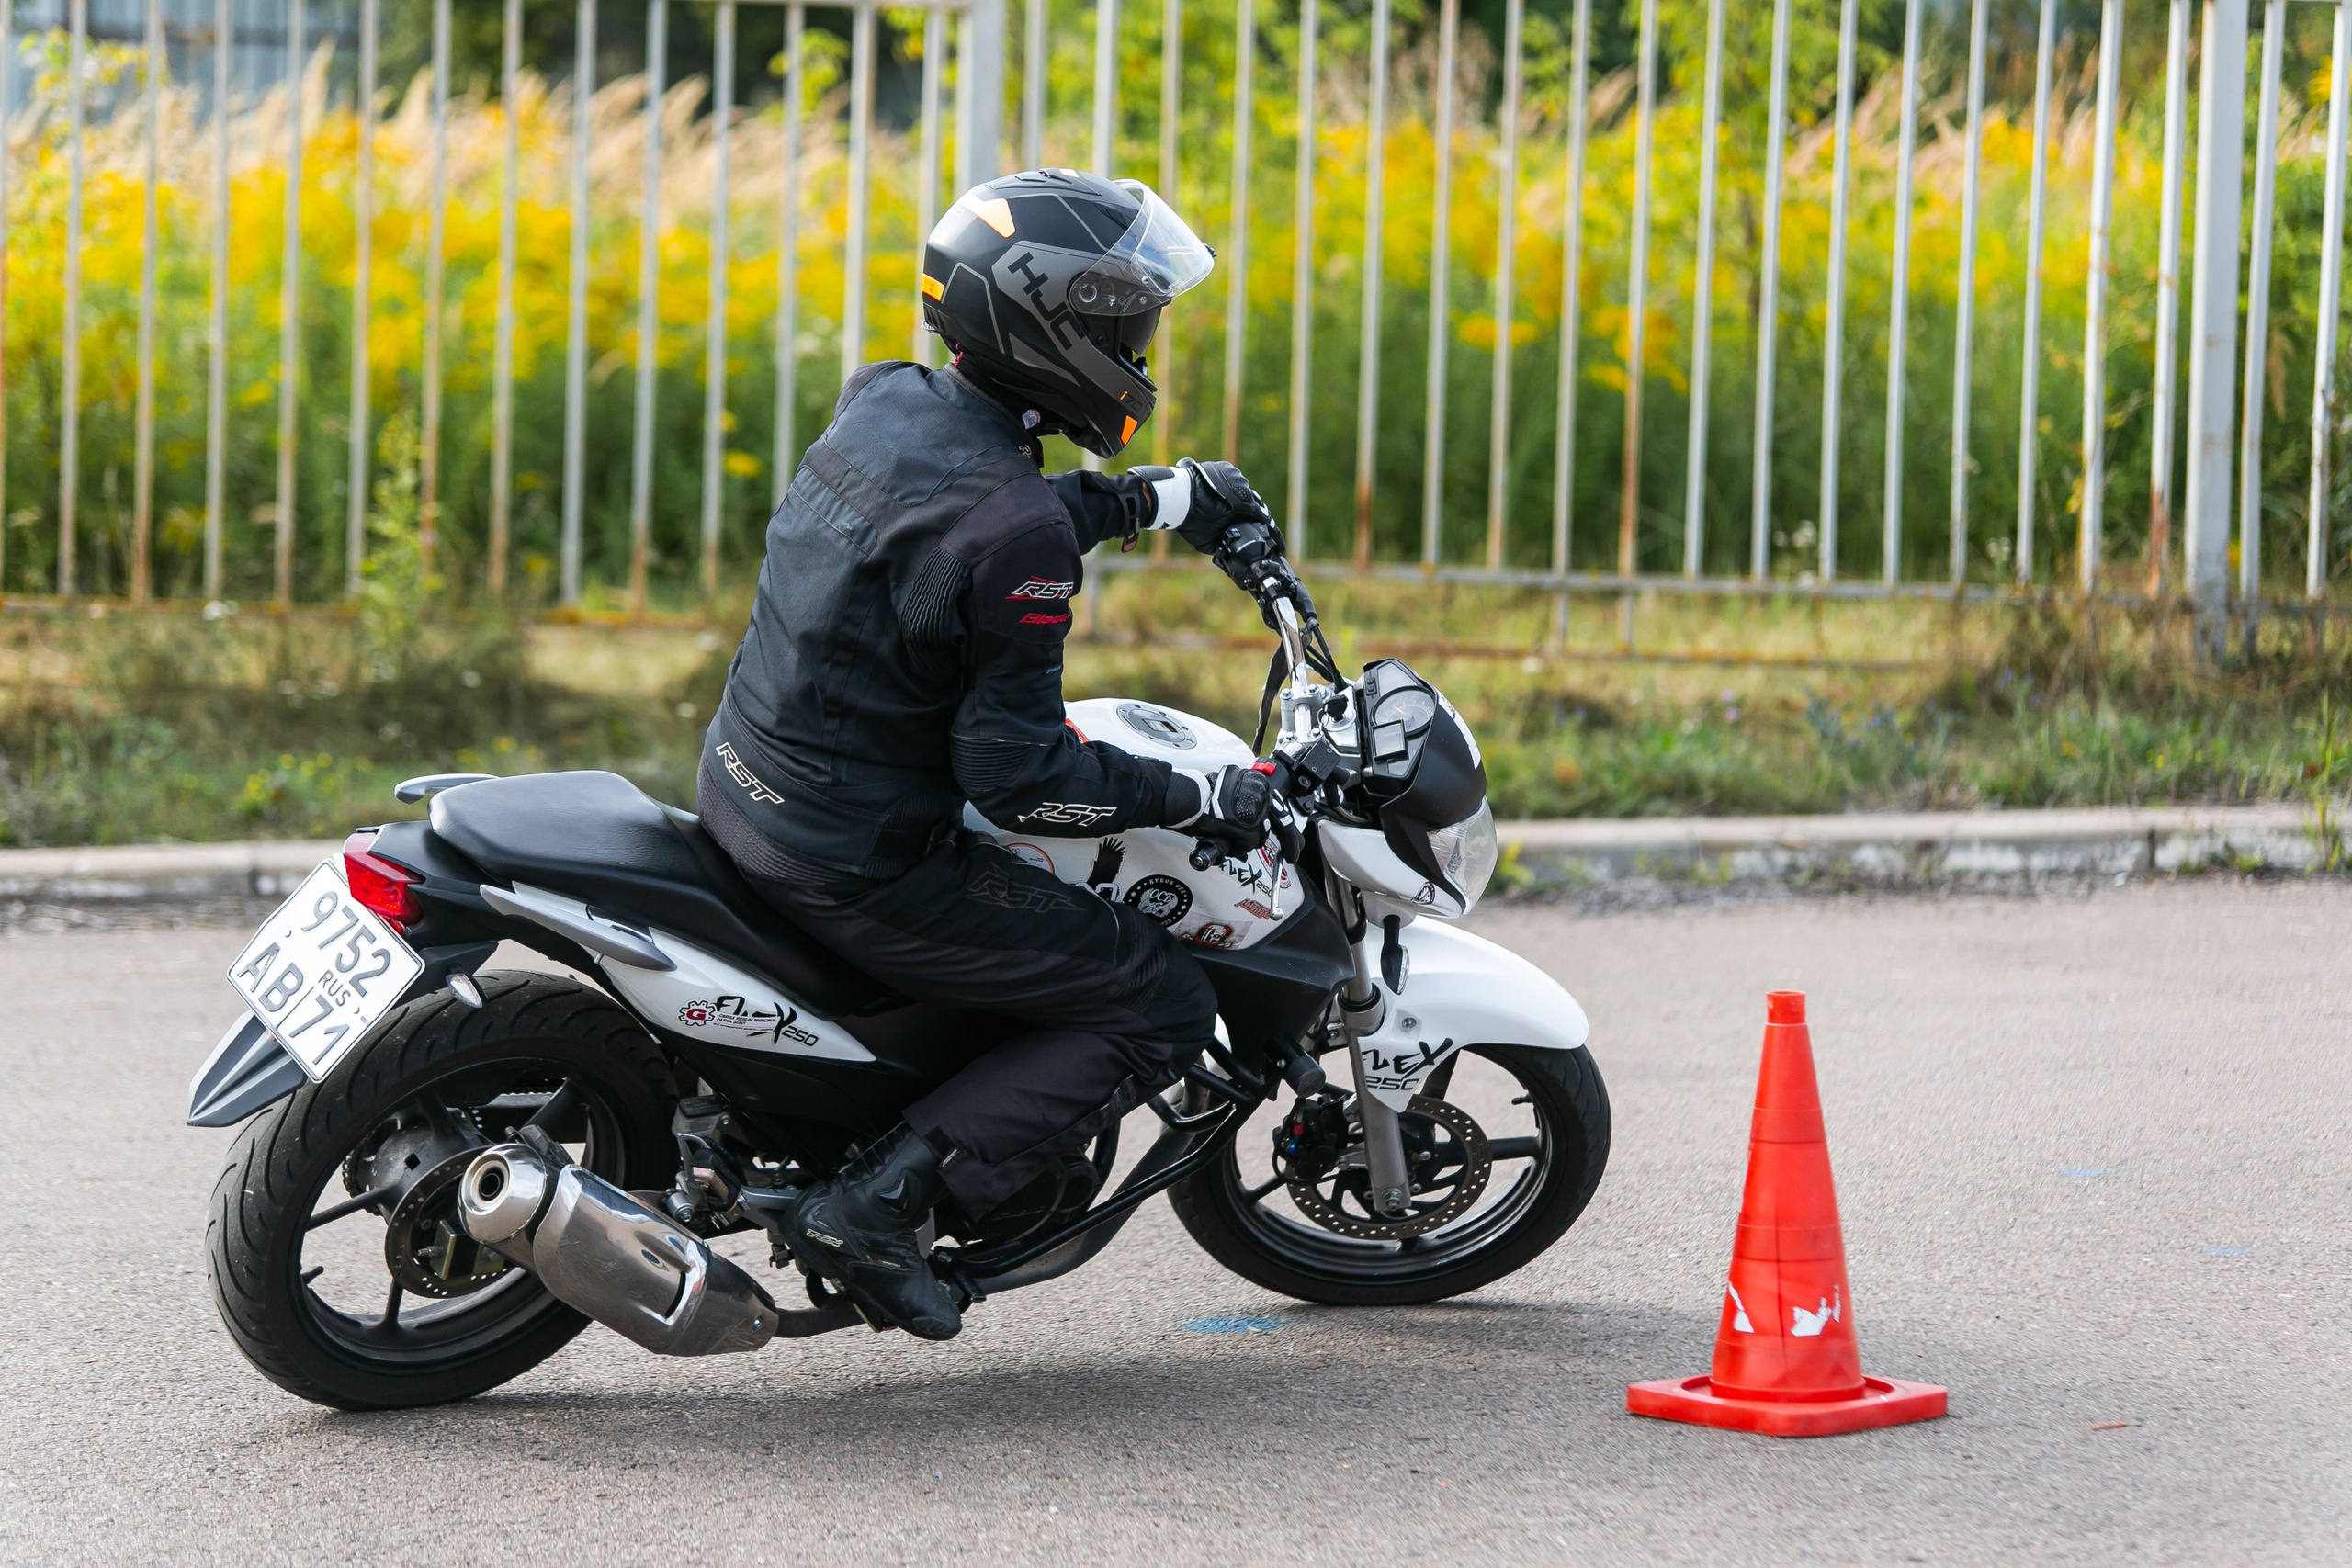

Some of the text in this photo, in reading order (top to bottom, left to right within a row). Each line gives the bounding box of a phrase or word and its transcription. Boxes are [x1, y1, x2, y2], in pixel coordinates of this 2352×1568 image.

[1007, 251, 1086, 351] HJC
[1011, 581, 1074, 599] RST
[716, 741, 785, 804] RST
[1017, 801, 1118, 827] RST
[967, 870, 1075, 913] RST
[300, 890, 391, 998] 9752
[236, 942, 350, 1066] AB 71
[318, 969, 351, 1007] RUS
[782, 1025, 820, 1047] 250
[1364, 1075, 1420, 1091] 250
